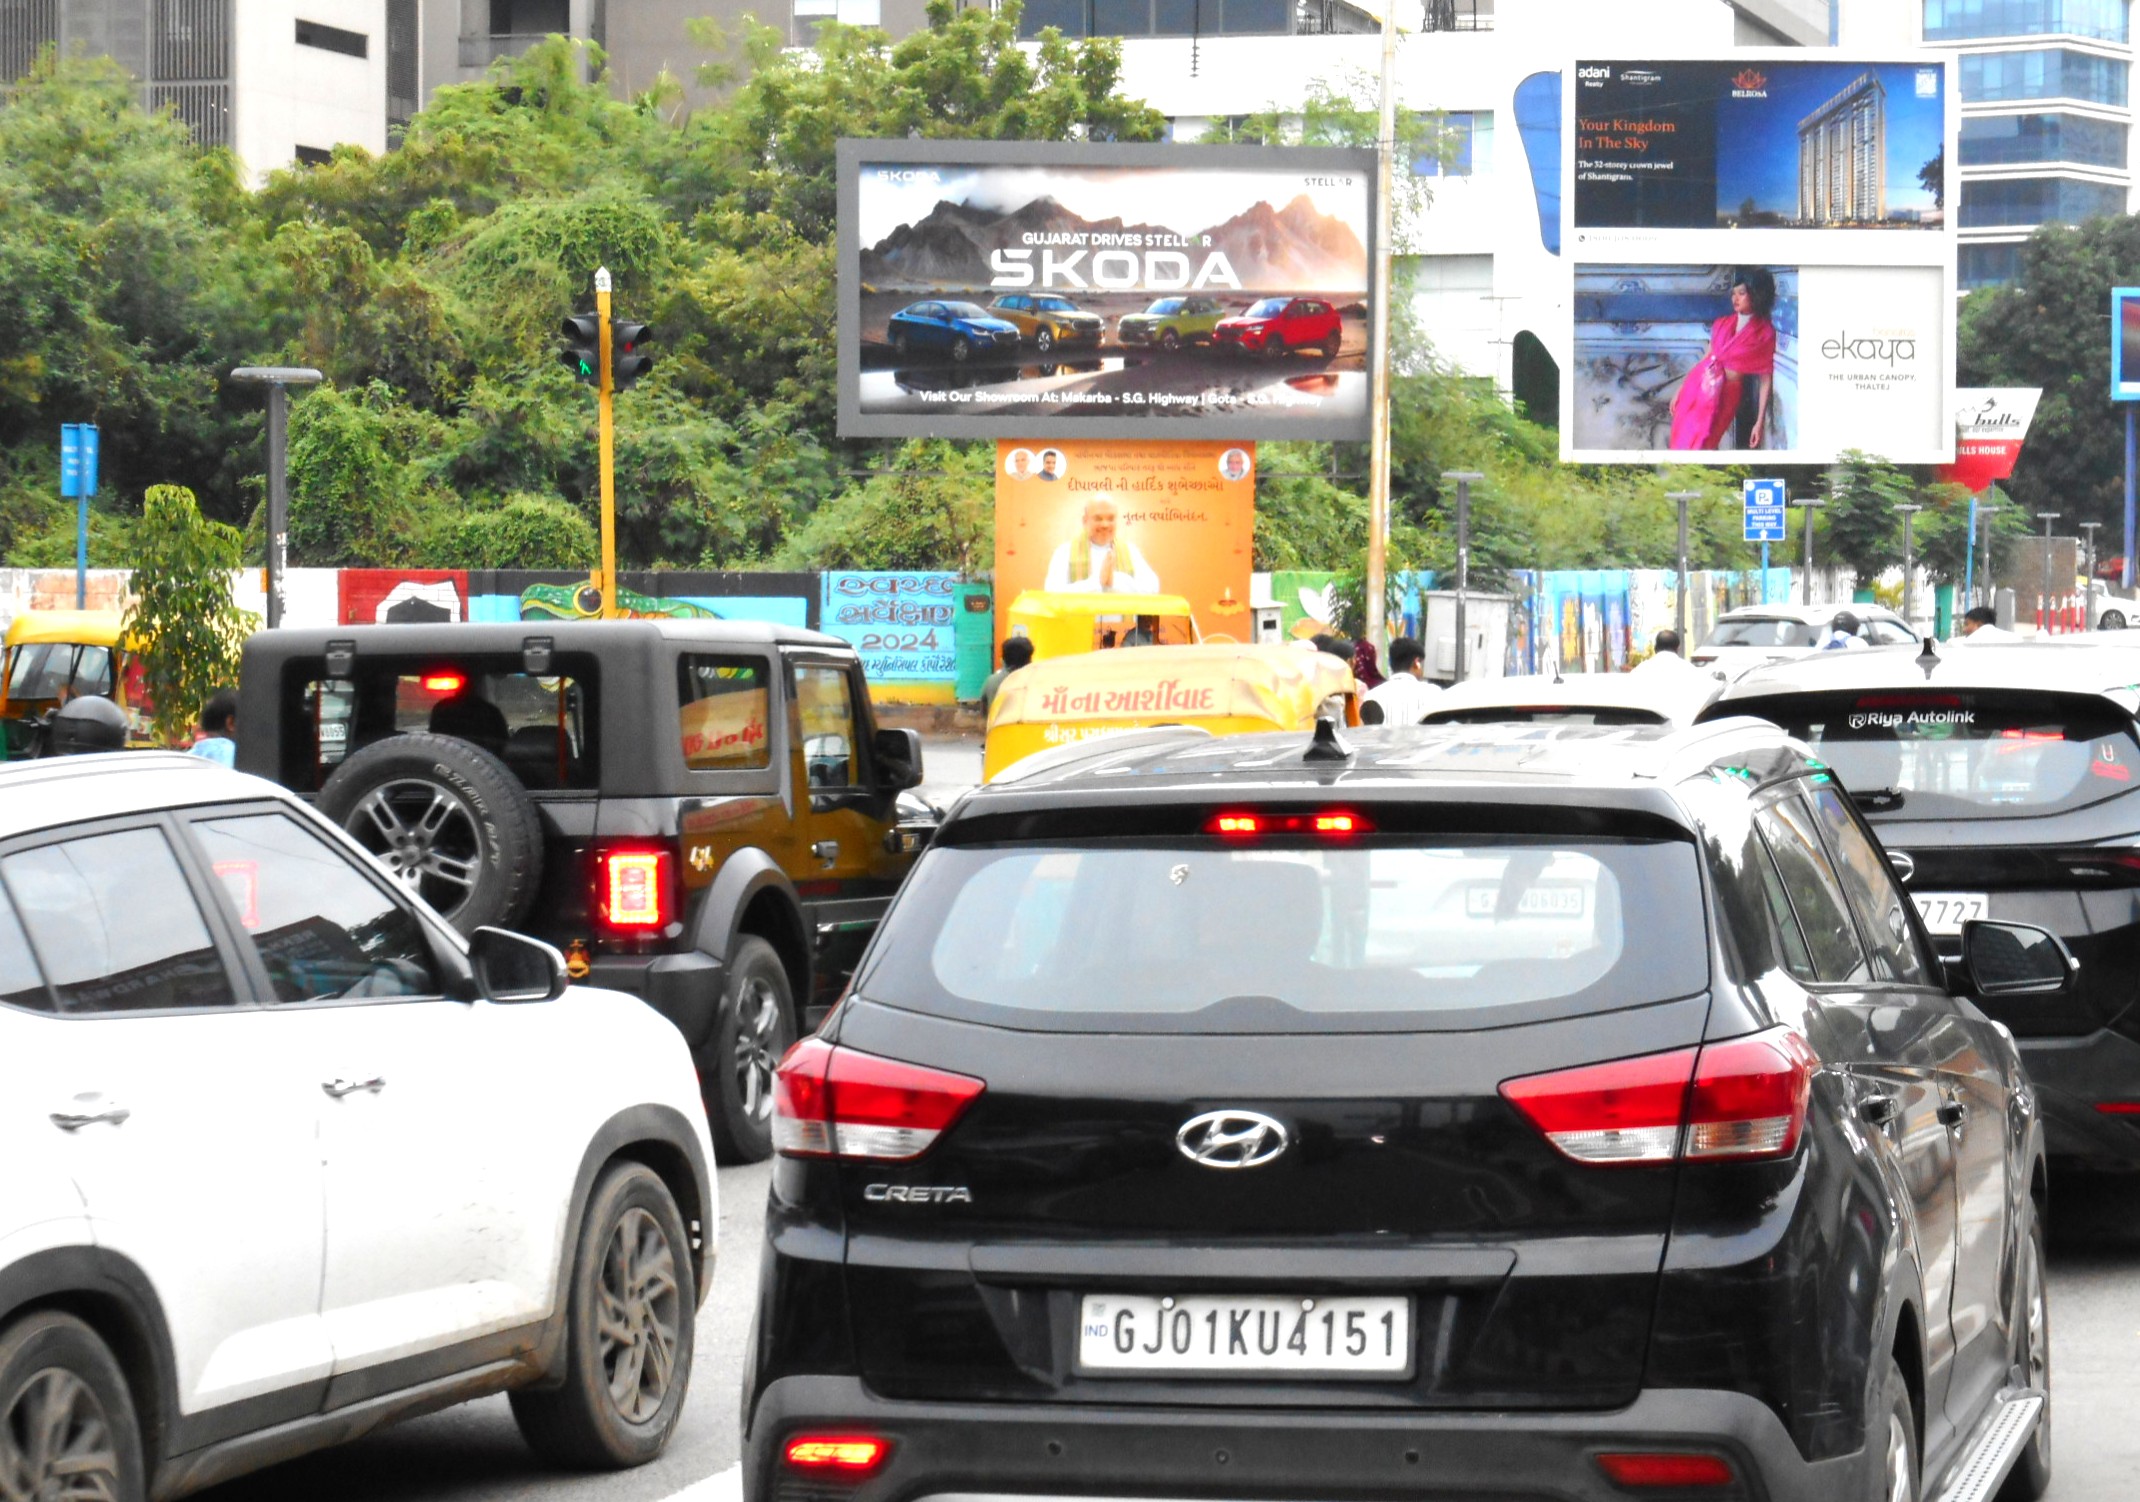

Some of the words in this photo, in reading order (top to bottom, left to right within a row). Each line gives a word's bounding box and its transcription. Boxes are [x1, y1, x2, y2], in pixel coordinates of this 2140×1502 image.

[1578, 66, 1610, 78] adani
[1579, 119, 1609, 132] Your
[1613, 119, 1675, 135] Kingdom
[1579, 137, 1593, 149] In
[1595, 136, 1622, 149] The
[1625, 136, 1648, 152] Sky
[1578, 160, 1593, 169] The
[1653, 161, 1674, 171] jewel
[1578, 172, 1587, 181] of
[1022, 232, 1088, 246] GUJARAT
[1091, 233, 1142, 247] DRIVES
[1821, 329, 1916, 368] ekaya
[1829, 373, 1844, 381] THE
[1847, 373, 1877, 381] URBAN
[1879, 373, 1916, 382] CANOPY,
[1855, 383, 1890, 391] THALTEJ
[920, 390, 947, 403] Visit
[949, 391, 971, 403] Our
[975, 391, 1039, 404] Showroom
[1041, 392, 1059, 404] At:
[1062, 392, 1112, 405] Makarba
[1123, 394, 1146, 405] S.G.
[1149, 393, 1199, 407] Highway
[1207, 394, 1237, 406] Gota
[1979, 446, 2006, 455] HOUSE
[1116, 477, 1128, 491] ની
[1132, 476, 1164, 491] હાર્દિક
[861, 629, 939, 651] 2024
[1867, 711, 1903, 727] Riya
[1906, 710, 1975, 724] Autolink
[863, 1183, 973, 1204] CRETA
[1084, 1325, 1108, 1337] IND
[1113, 1308, 1395, 1357] GJ01KU4151
